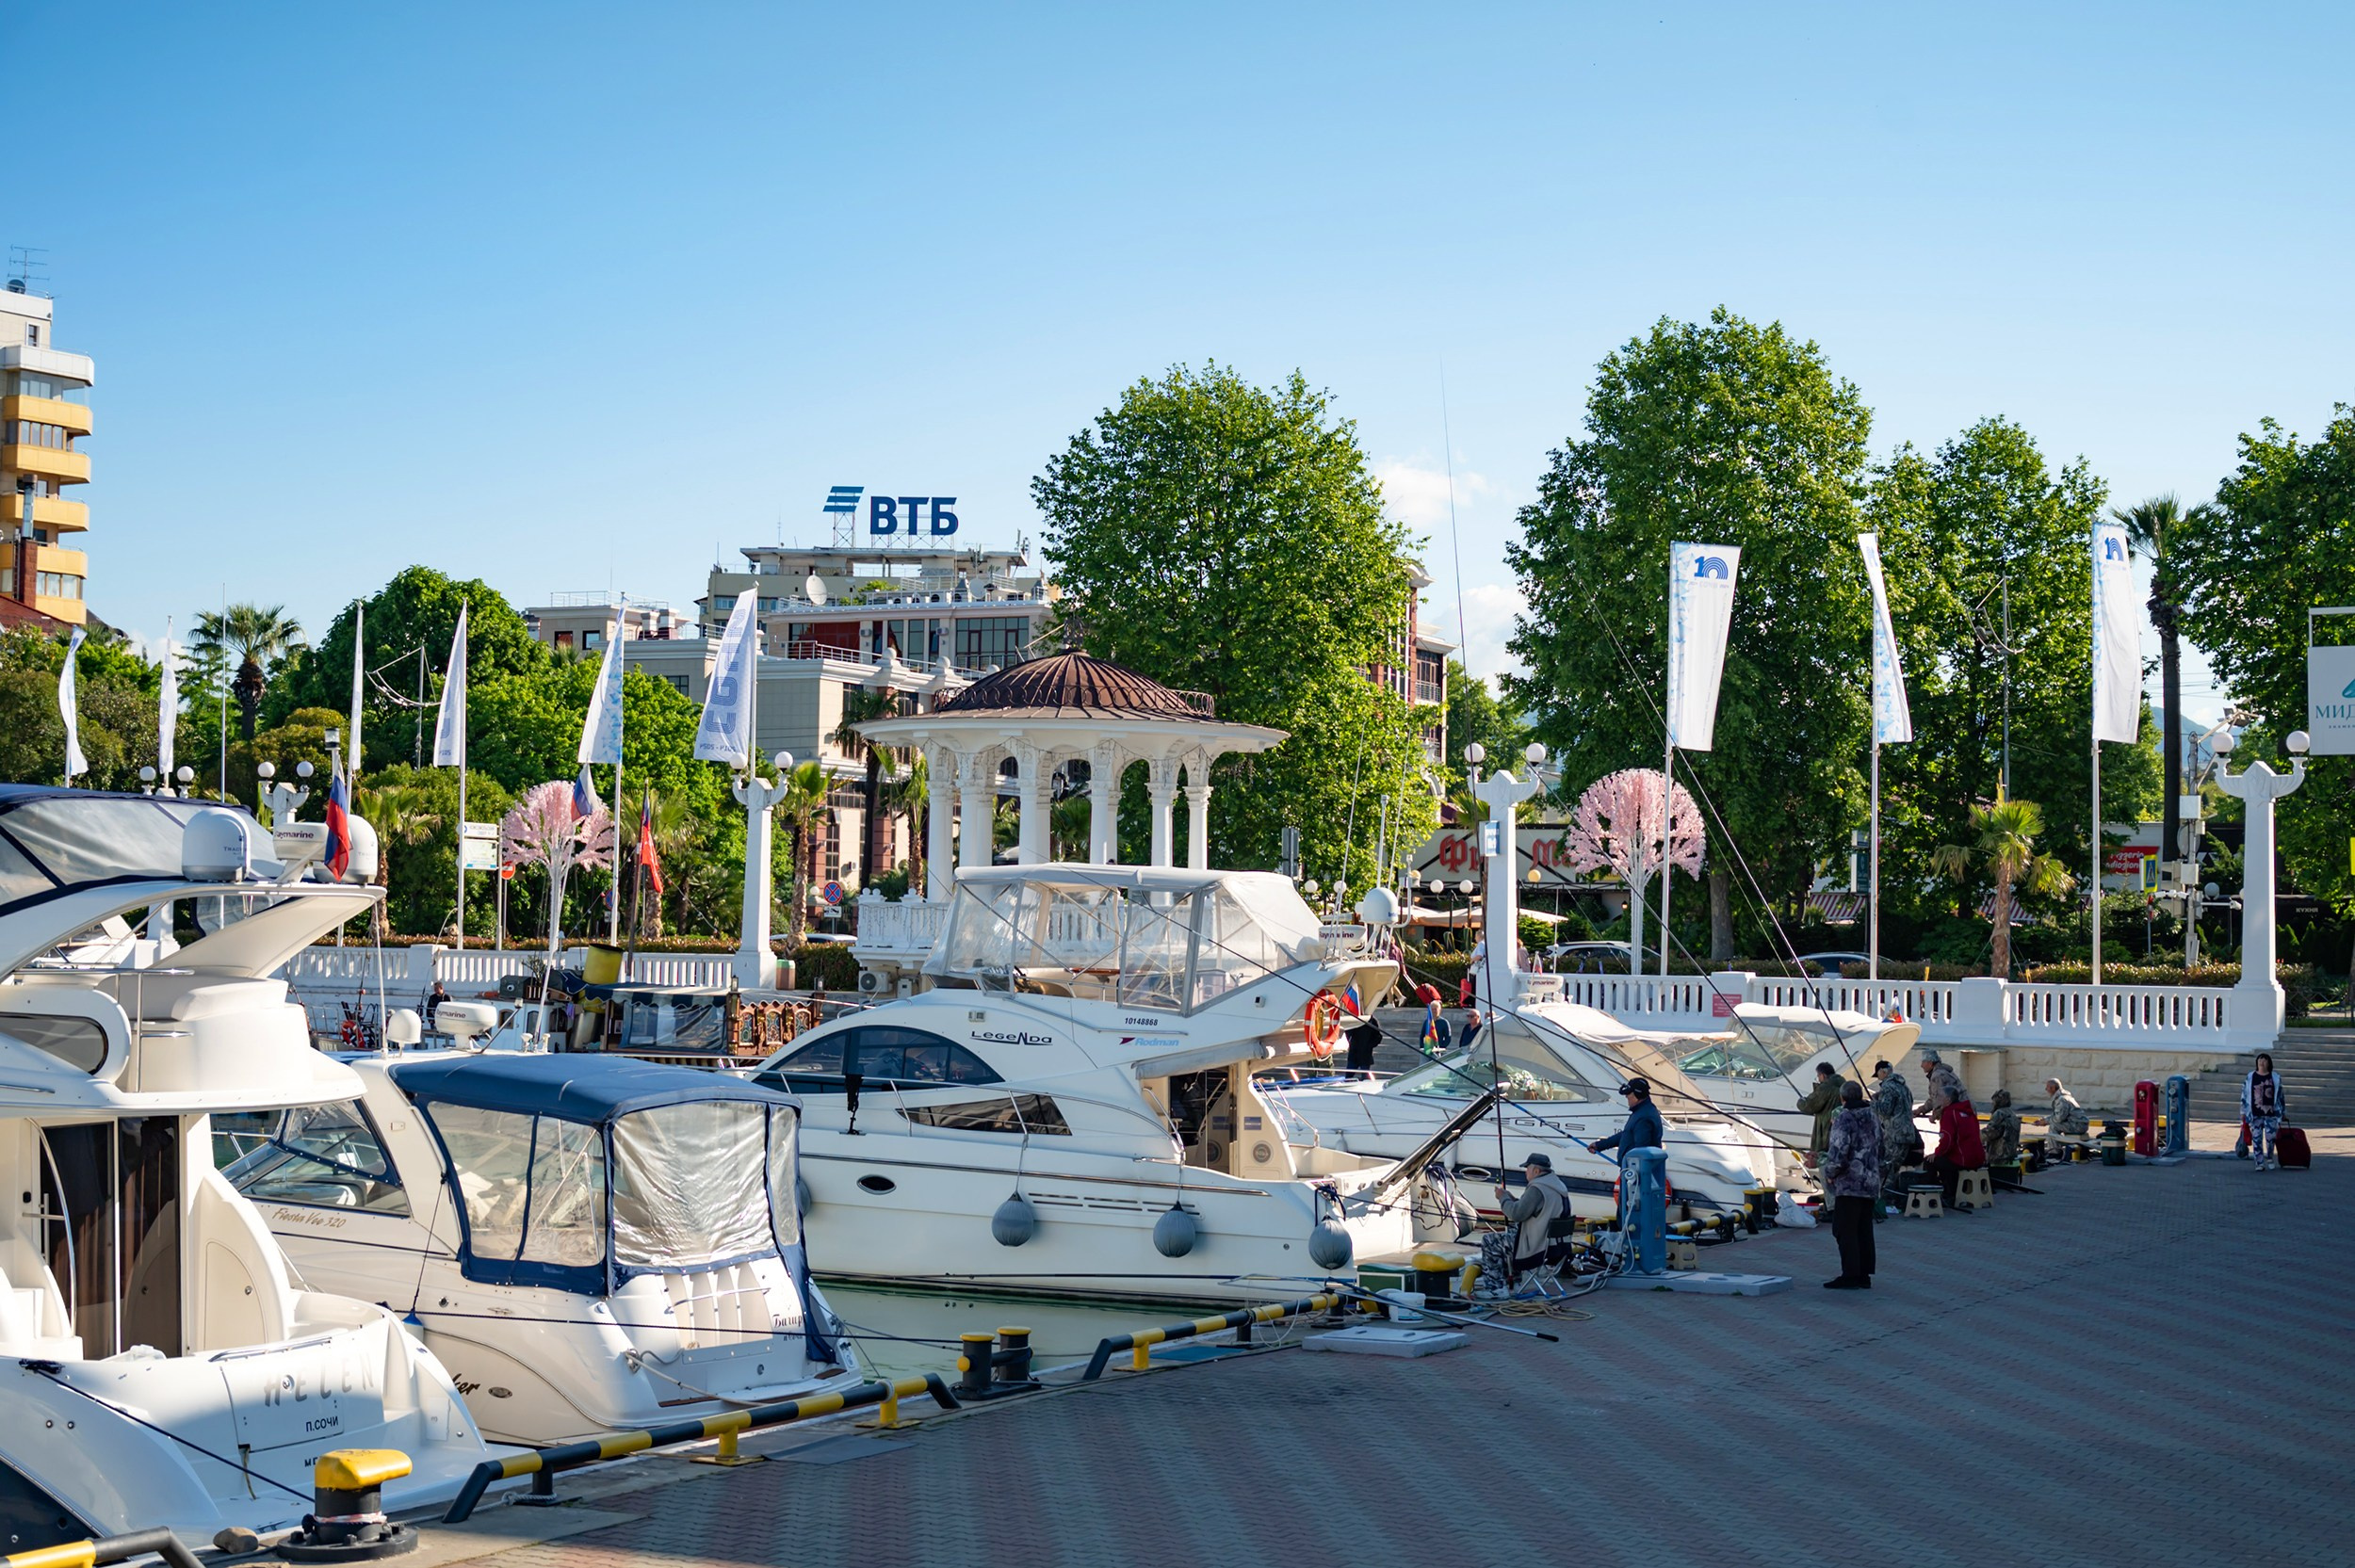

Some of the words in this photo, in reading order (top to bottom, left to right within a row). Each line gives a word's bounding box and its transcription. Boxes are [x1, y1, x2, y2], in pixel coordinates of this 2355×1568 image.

[870, 495, 959, 536] ВТБ
[1125, 1017, 1159, 1026] 10148868
[1135, 1037, 1179, 1046] Rodman
[271, 1207, 305, 1223] Fiesta
[305, 1212, 324, 1226] Vee
[324, 1216, 348, 1228] 320
[264, 1353, 375, 1407] HELEN
[305, 1415, 339, 1432] П.СОЧИ
